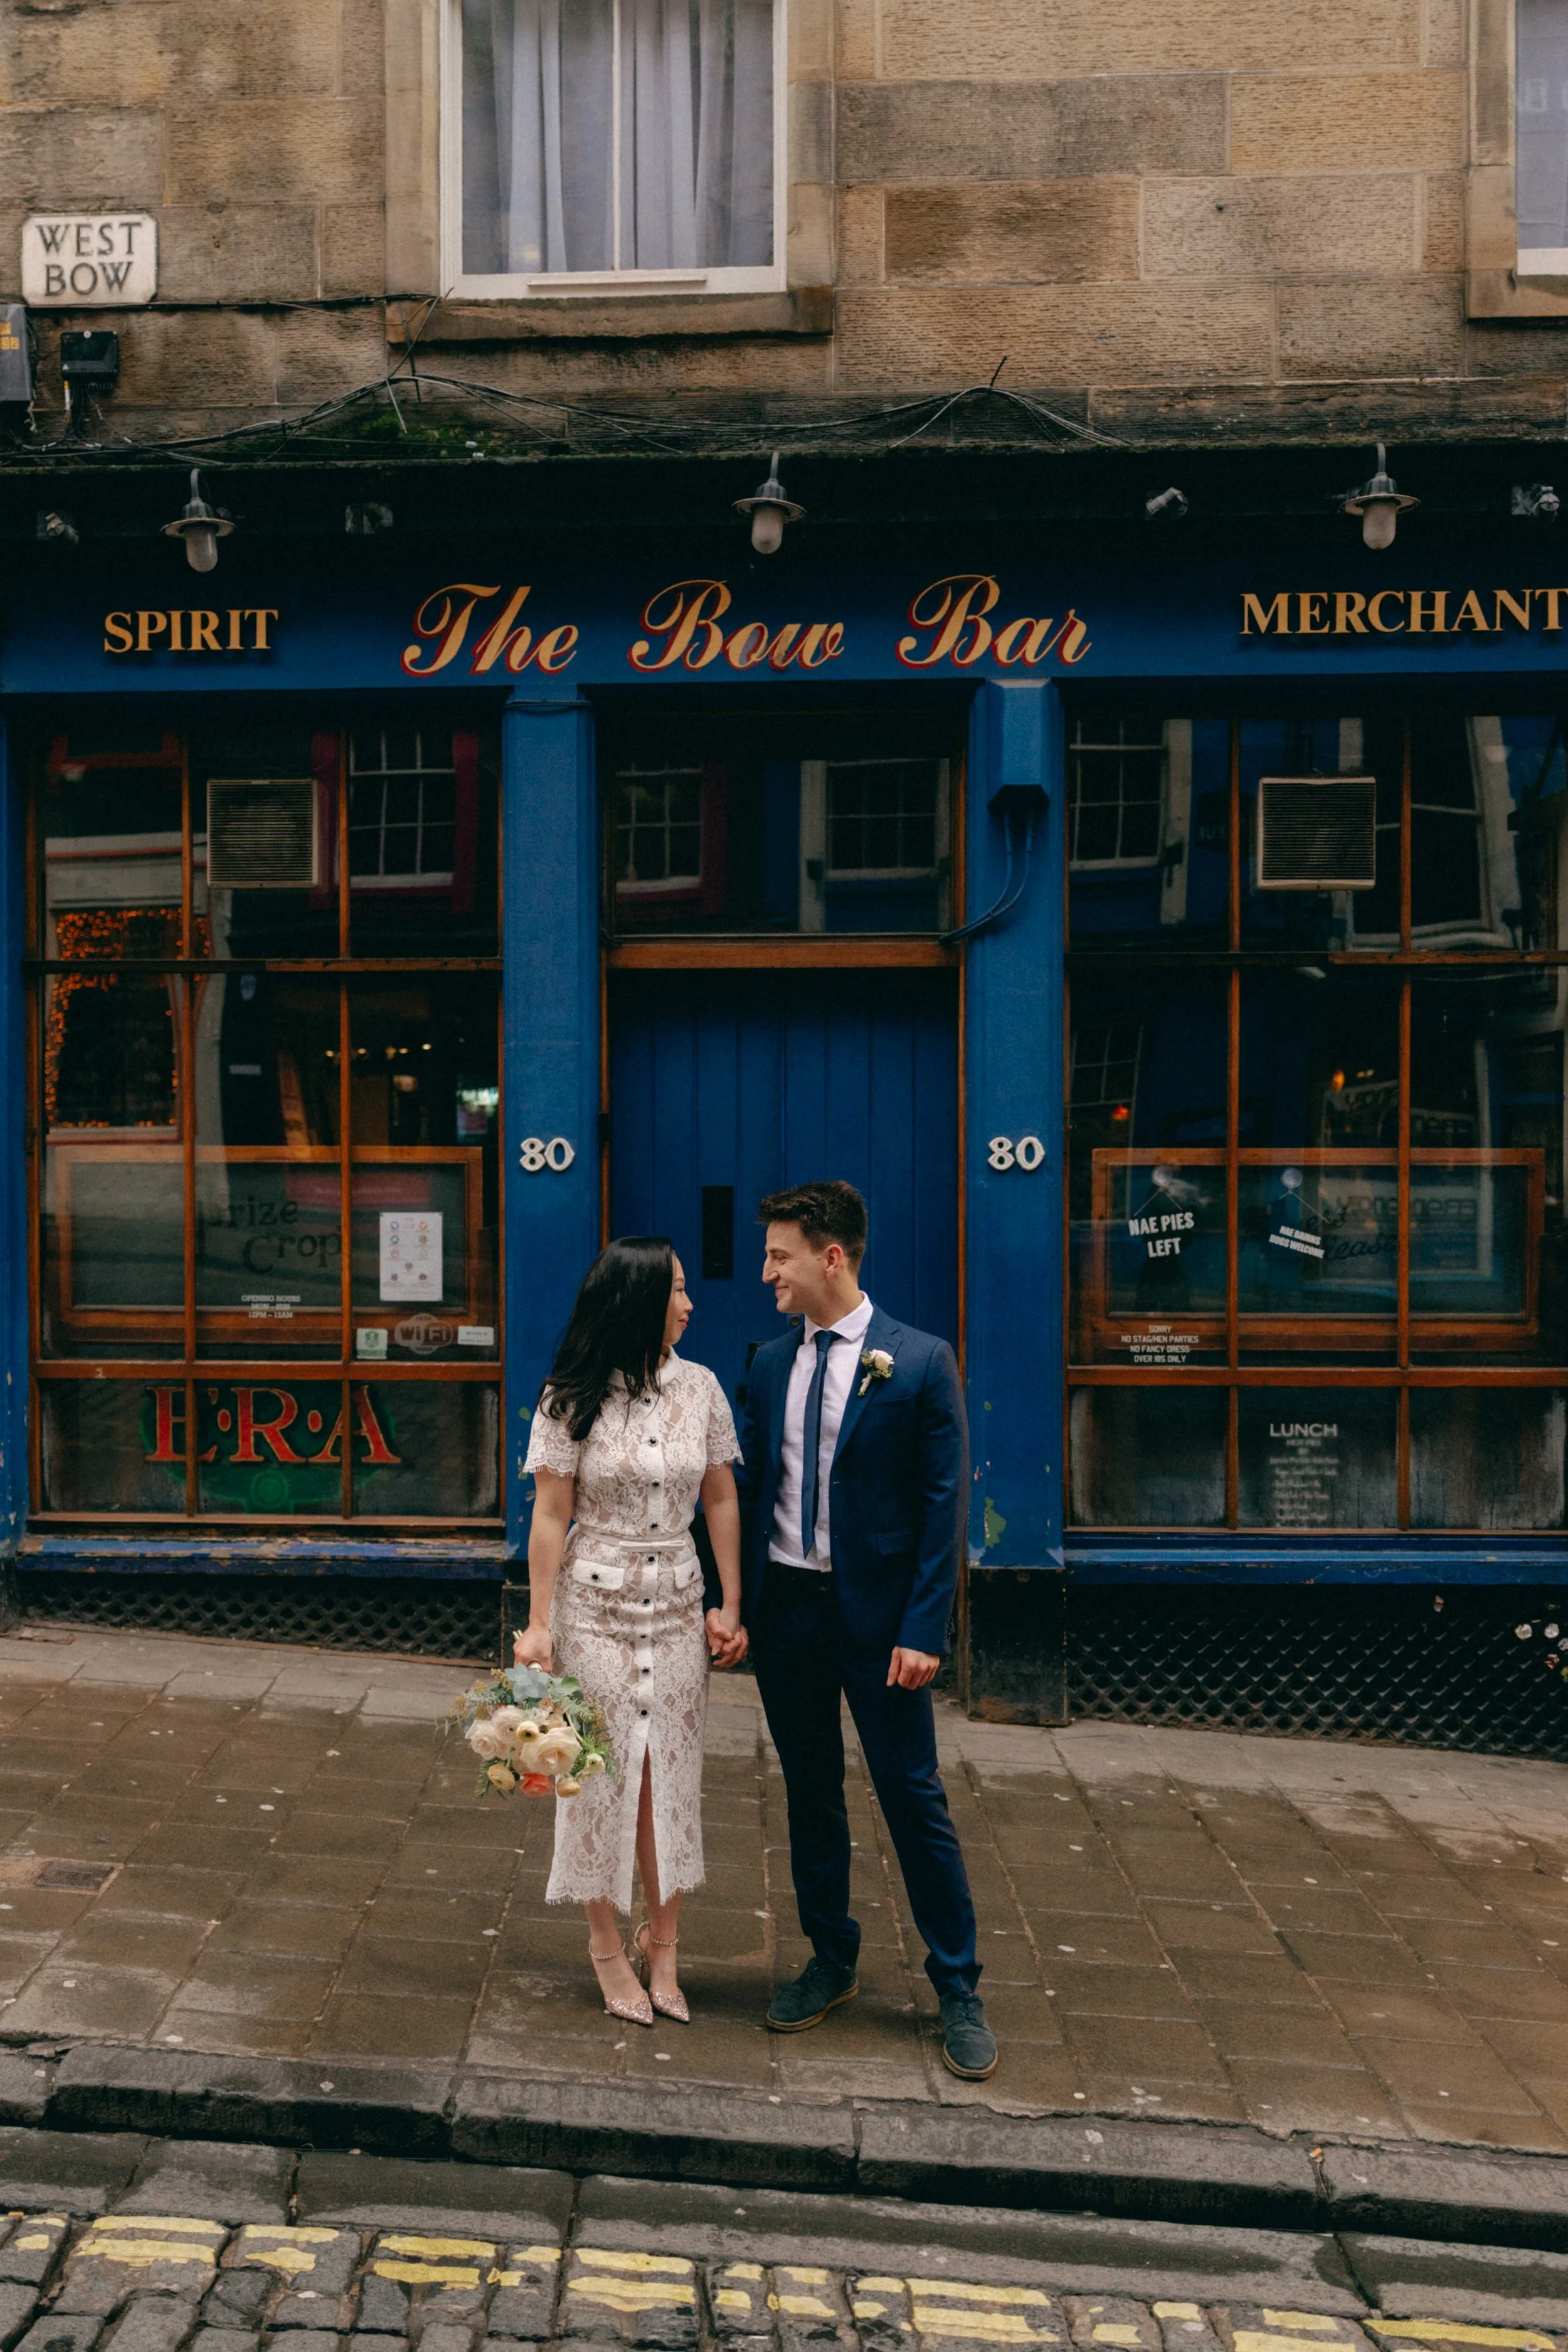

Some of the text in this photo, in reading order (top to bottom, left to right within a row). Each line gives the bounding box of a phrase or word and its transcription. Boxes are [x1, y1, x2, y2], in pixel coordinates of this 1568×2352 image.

[35, 222, 142, 257] WEST
[45, 262, 134, 297] BOW
[1239, 588, 1568, 634] MERCHANT
[104, 609, 279, 654] SPIRIT
[400, 573, 1093, 677] The Bow Bar
[519, 1136, 575, 1173] 80
[988, 1136, 1046, 1172] 80
[1128, 1211, 1195, 1236] NAE PIES
[1279, 1225, 1295, 1237] NAE
[1147, 1237, 1181, 1258] LEFT
[1269, 1234, 1325, 1259] DUGS WELCOME
[1121, 1335, 1199, 1343] NO STAG/HEN PARTIES
[1148, 1325, 1172, 1333] SORRY
[1130, 1345, 1190, 1353] NO FANCY DRESS
[1134, 1355, 1153, 1363] OVER
[1167, 1355, 1187, 1363] ONLY
[1269, 1422, 1338, 1437] LUNCH
